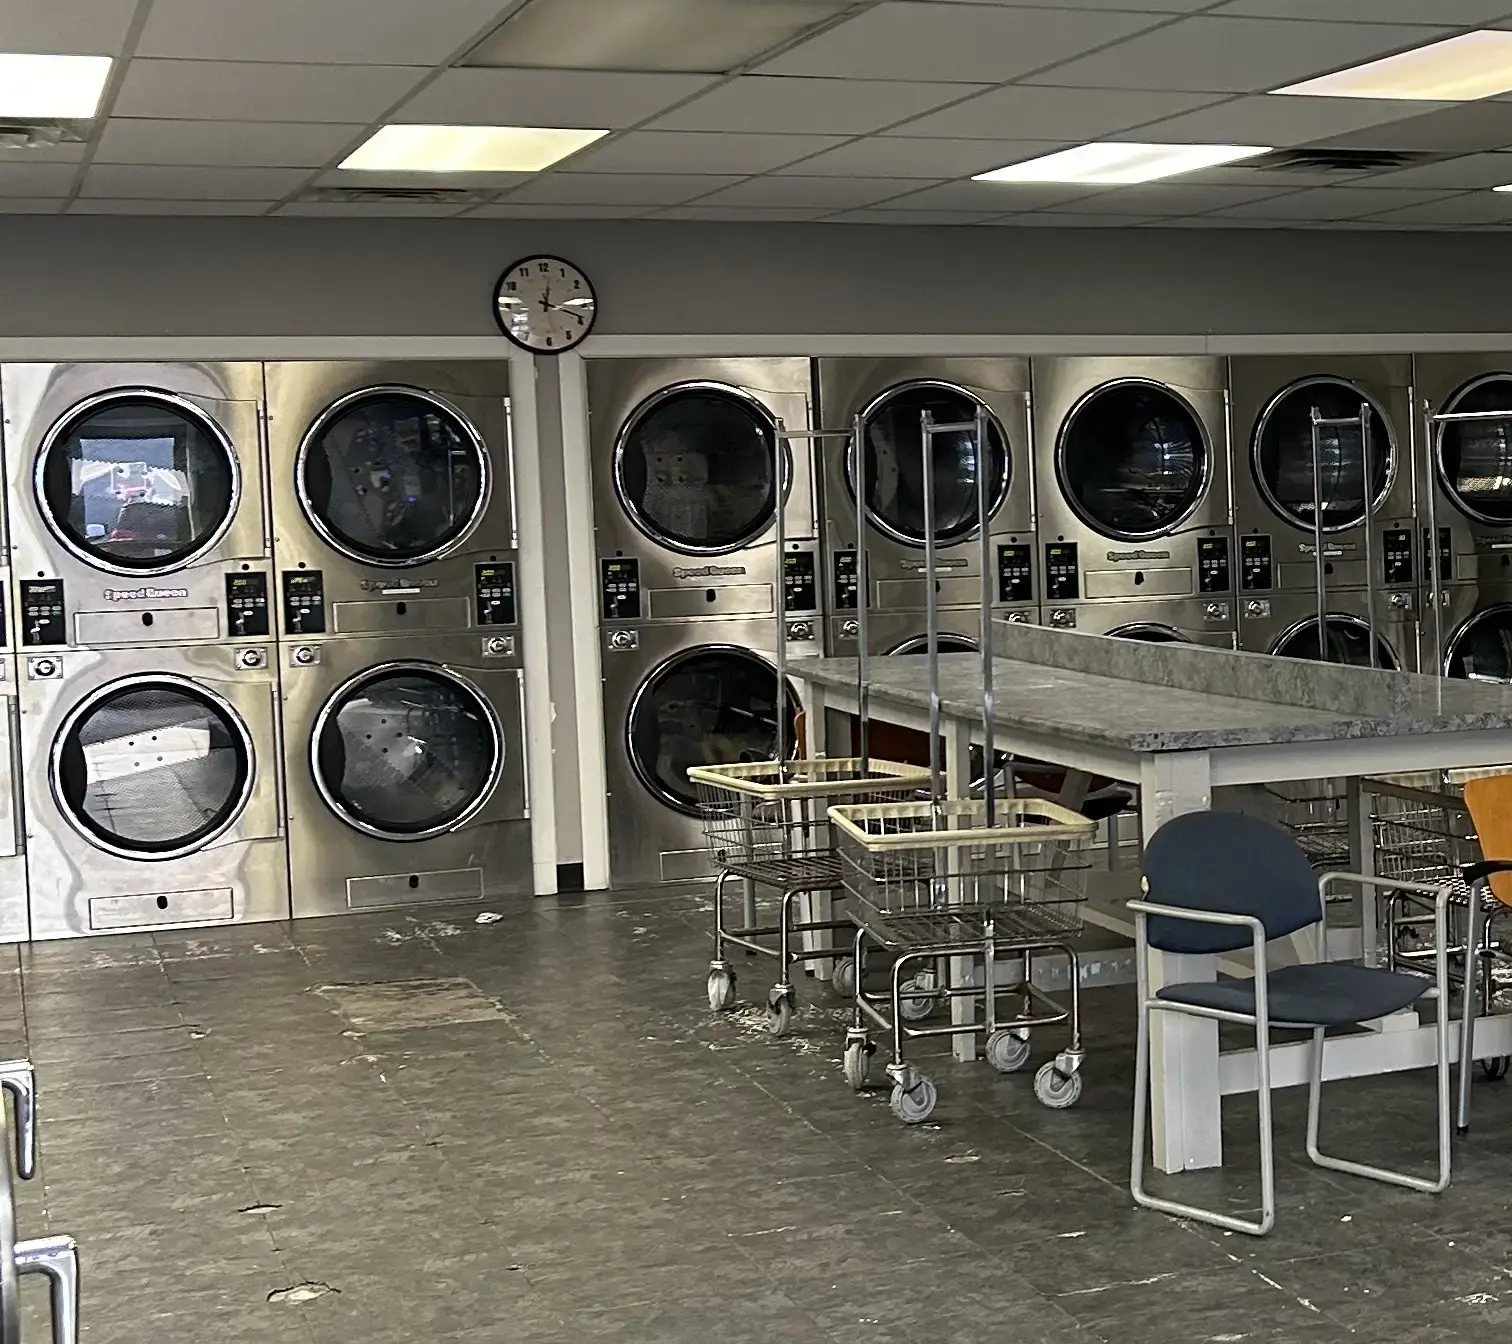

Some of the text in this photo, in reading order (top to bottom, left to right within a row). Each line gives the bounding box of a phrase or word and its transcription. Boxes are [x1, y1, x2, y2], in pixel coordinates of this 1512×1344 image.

[519, 267, 529, 277] 11
[538, 262, 549, 273] 12
[560, 268, 565, 278] 1
[506, 281, 517, 291] 10
[574, 280, 580, 289] 2
[566, 330, 572, 340] 5
[546, 337, 552, 347] 6
[673, 565, 746, 578] Speed Queen
[104, 587, 188, 601] Speed Queen
